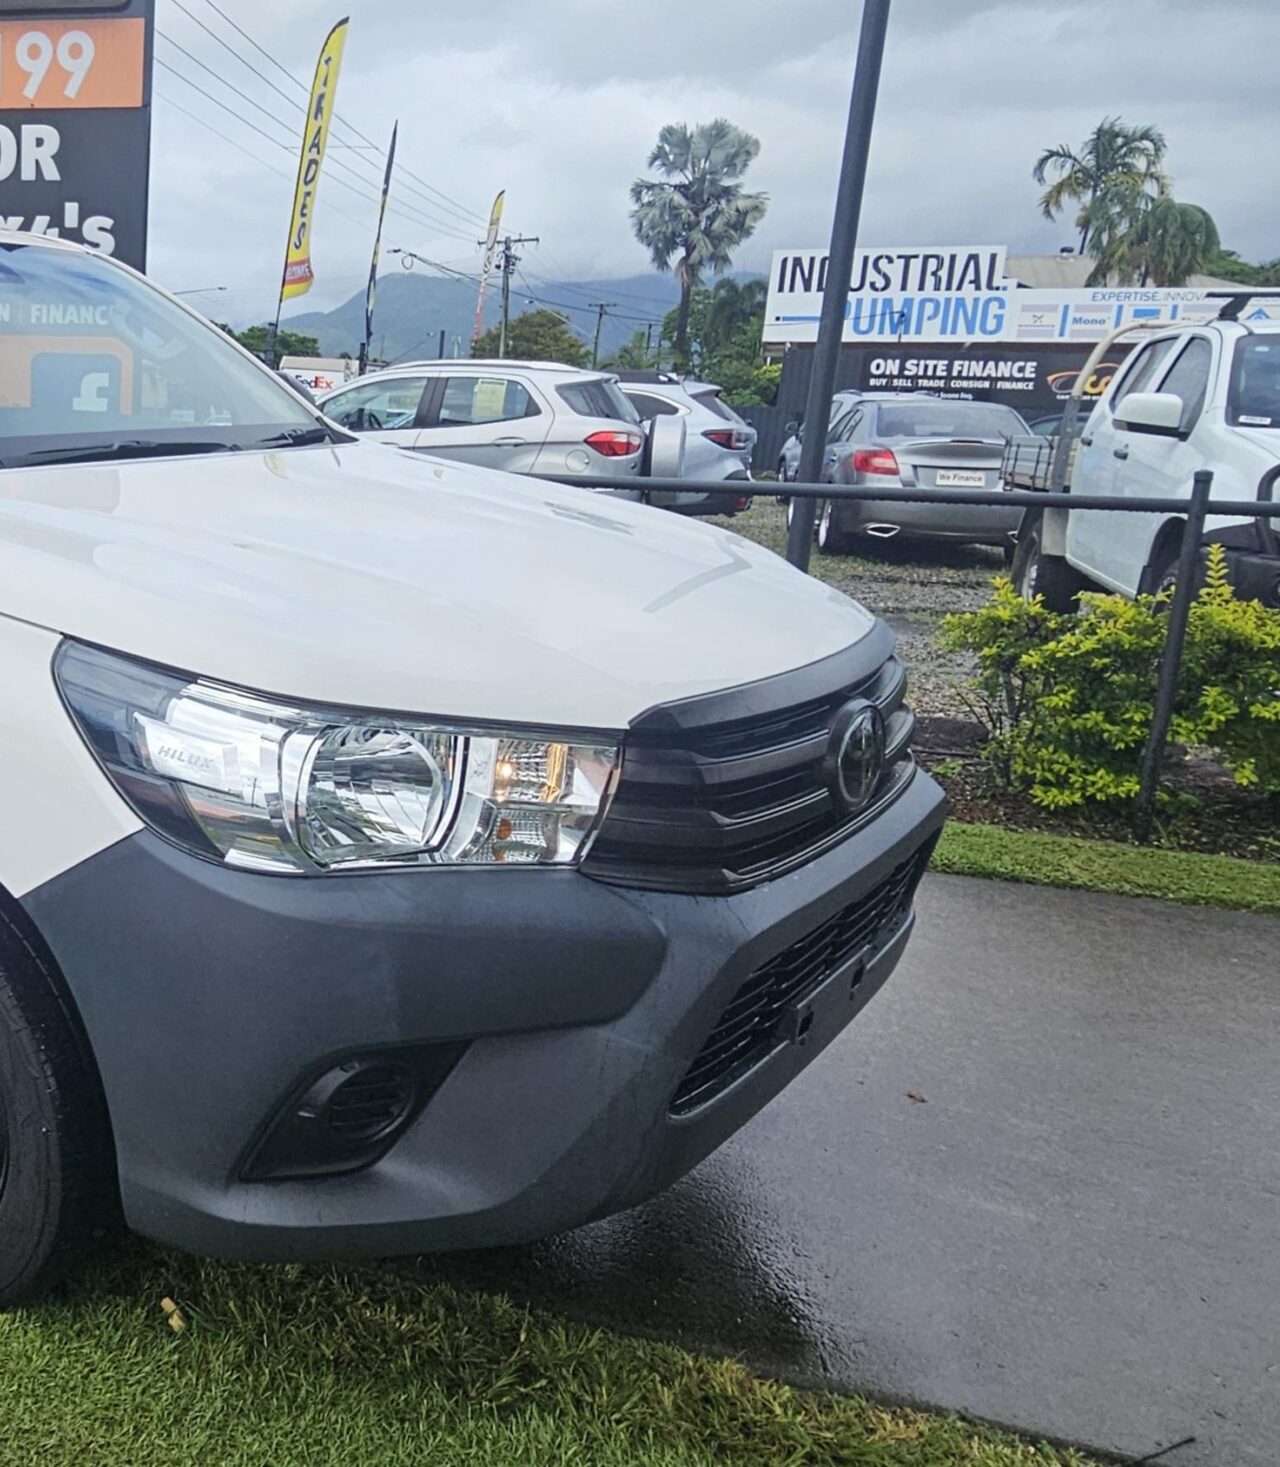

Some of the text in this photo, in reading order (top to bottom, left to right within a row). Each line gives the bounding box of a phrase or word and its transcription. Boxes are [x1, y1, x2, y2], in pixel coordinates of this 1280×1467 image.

[30, 303, 113, 326] FINANC
[870, 358, 1037, 378] ON SITE FINANCE
[869, 378, 1035, 390] BUY SELL TRADE CONSIGN FINANCE
[939, 473, 983, 482] We Finance
[157, 745, 215, 769] HILUX
